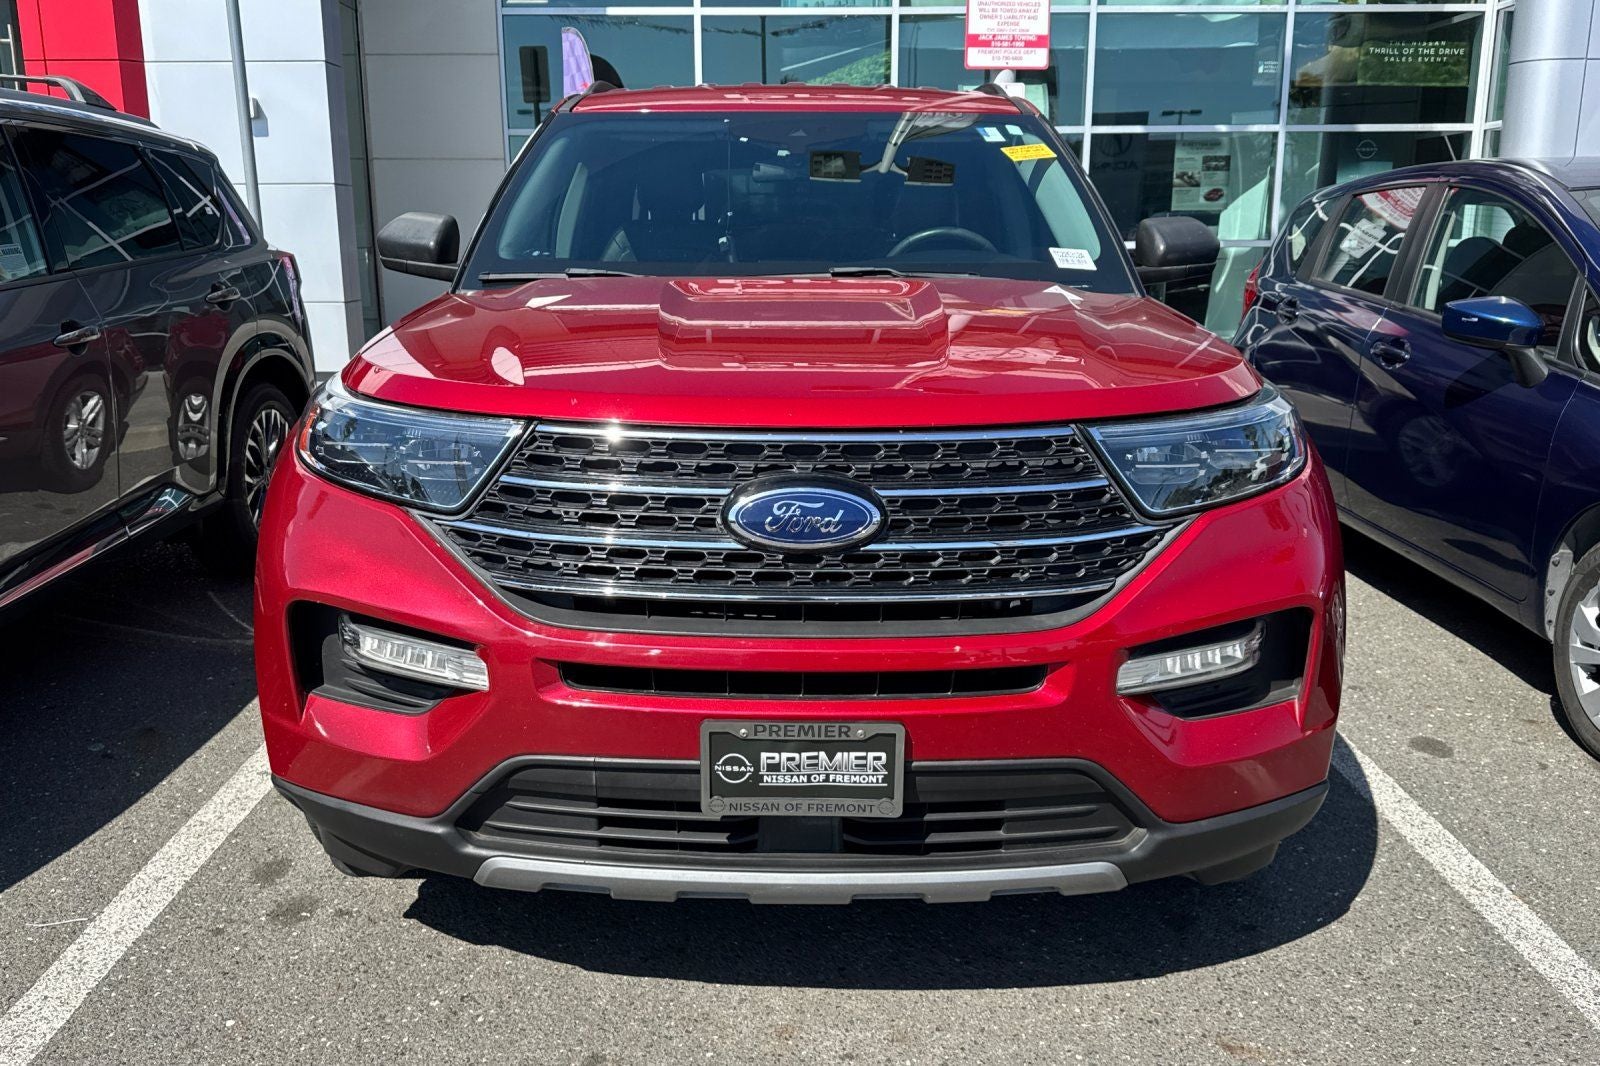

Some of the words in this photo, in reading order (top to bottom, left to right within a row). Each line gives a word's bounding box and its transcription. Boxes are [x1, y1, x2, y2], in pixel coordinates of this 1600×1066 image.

[1369, 47, 1399, 55] THRILL
[1402, 47, 1415, 55] OF
[764, 500, 844, 533] Ford
[753, 724, 851, 739] PREMIER
[759, 751, 888, 773] PREMIER
[714, 764, 754, 772] NISSAN
[763, 774, 807, 784] NISSAN
[811, 774, 826, 783] OF
[829, 774, 885, 784] FREMONT
[729, 802, 780, 812] NISSAN
[784, 802, 803, 812] OF
[807, 803, 876, 813] FREMONT
